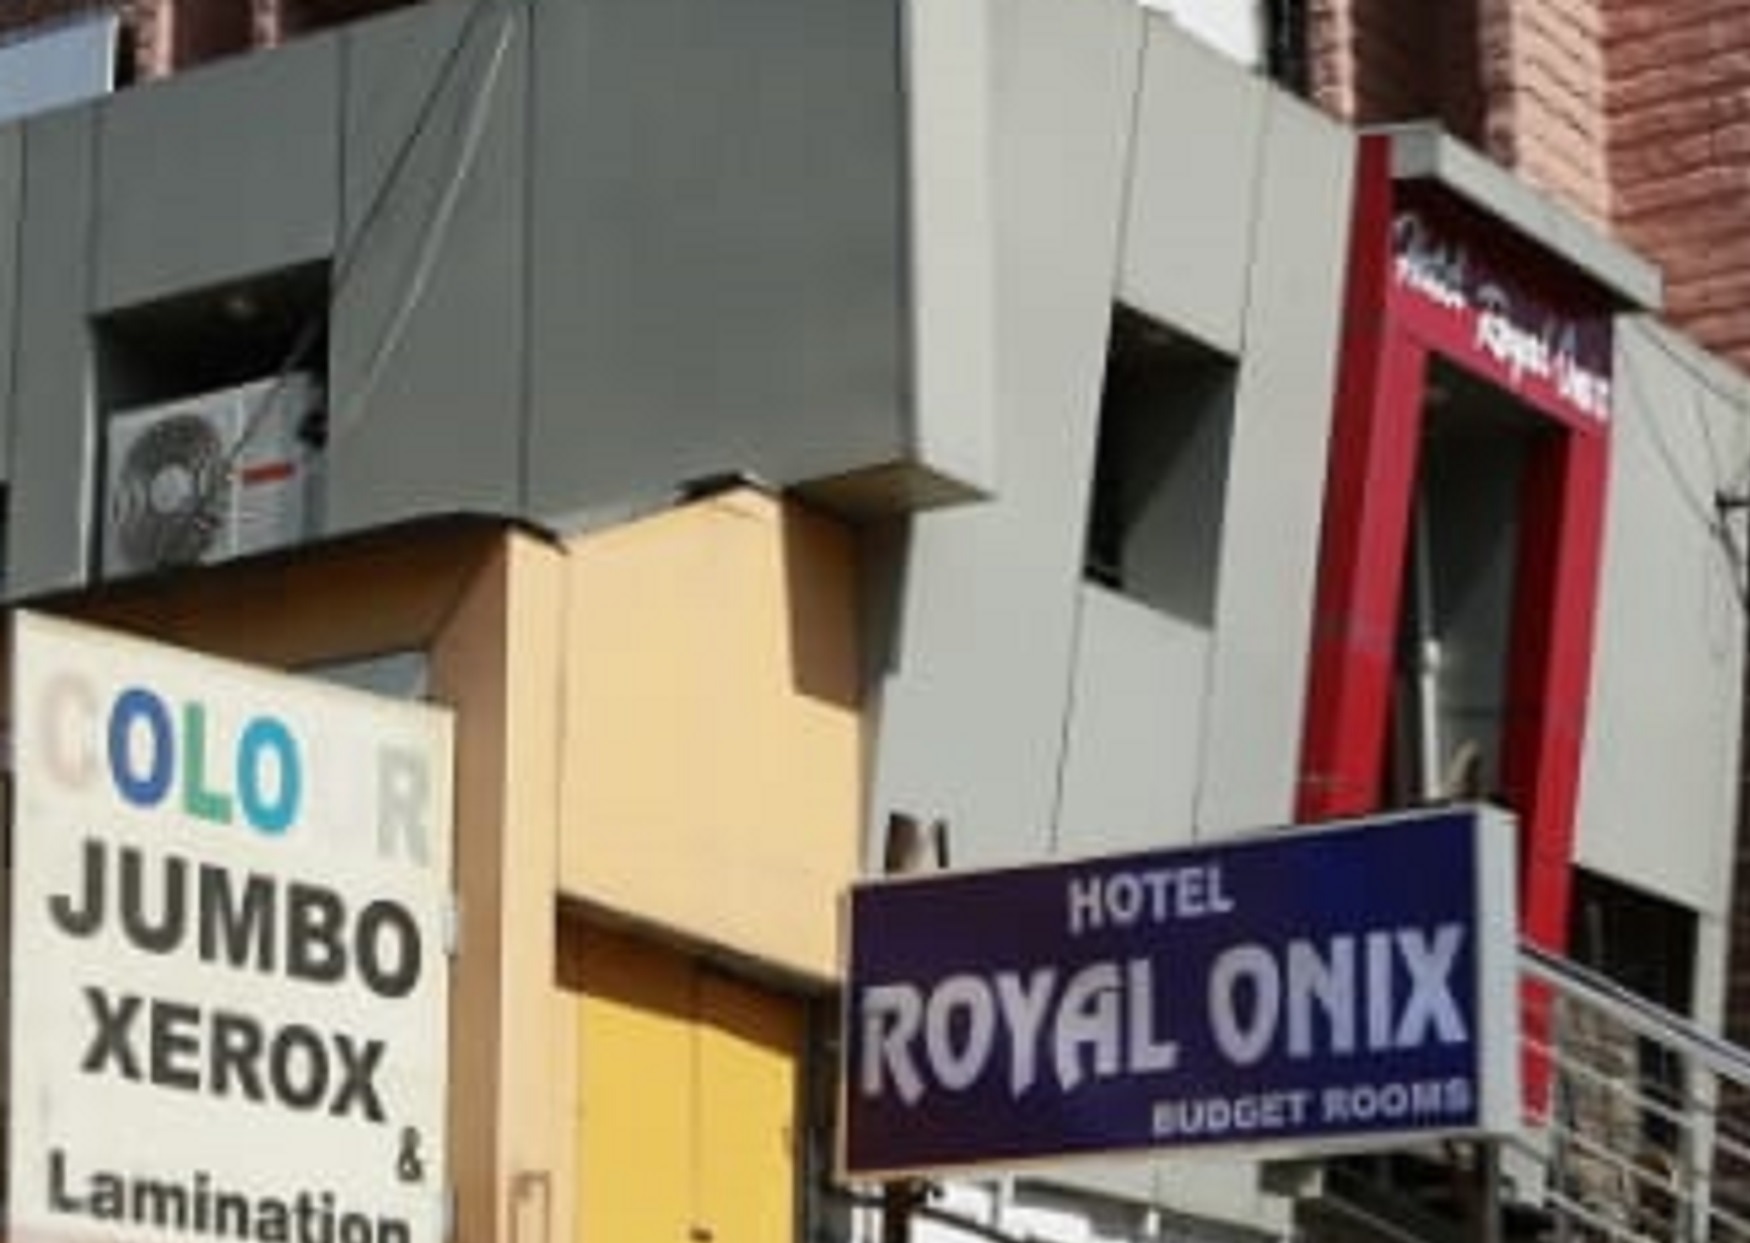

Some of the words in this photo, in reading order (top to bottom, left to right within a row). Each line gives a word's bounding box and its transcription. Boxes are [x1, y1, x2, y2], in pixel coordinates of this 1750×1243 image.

[41, 670, 432, 868] COLOR
[48, 836, 421, 999] JUMBO
[1068, 867, 1233, 933] HOTEL
[81, 984, 386, 1123] XEROX
[861, 959, 1178, 1105] ROYAL
[1208, 925, 1468, 1064] ONIX
[397, 1126, 424, 1183] &
[1152, 1093, 1306, 1136] BUDGET
[1323, 1078, 1470, 1121] ROOMS
